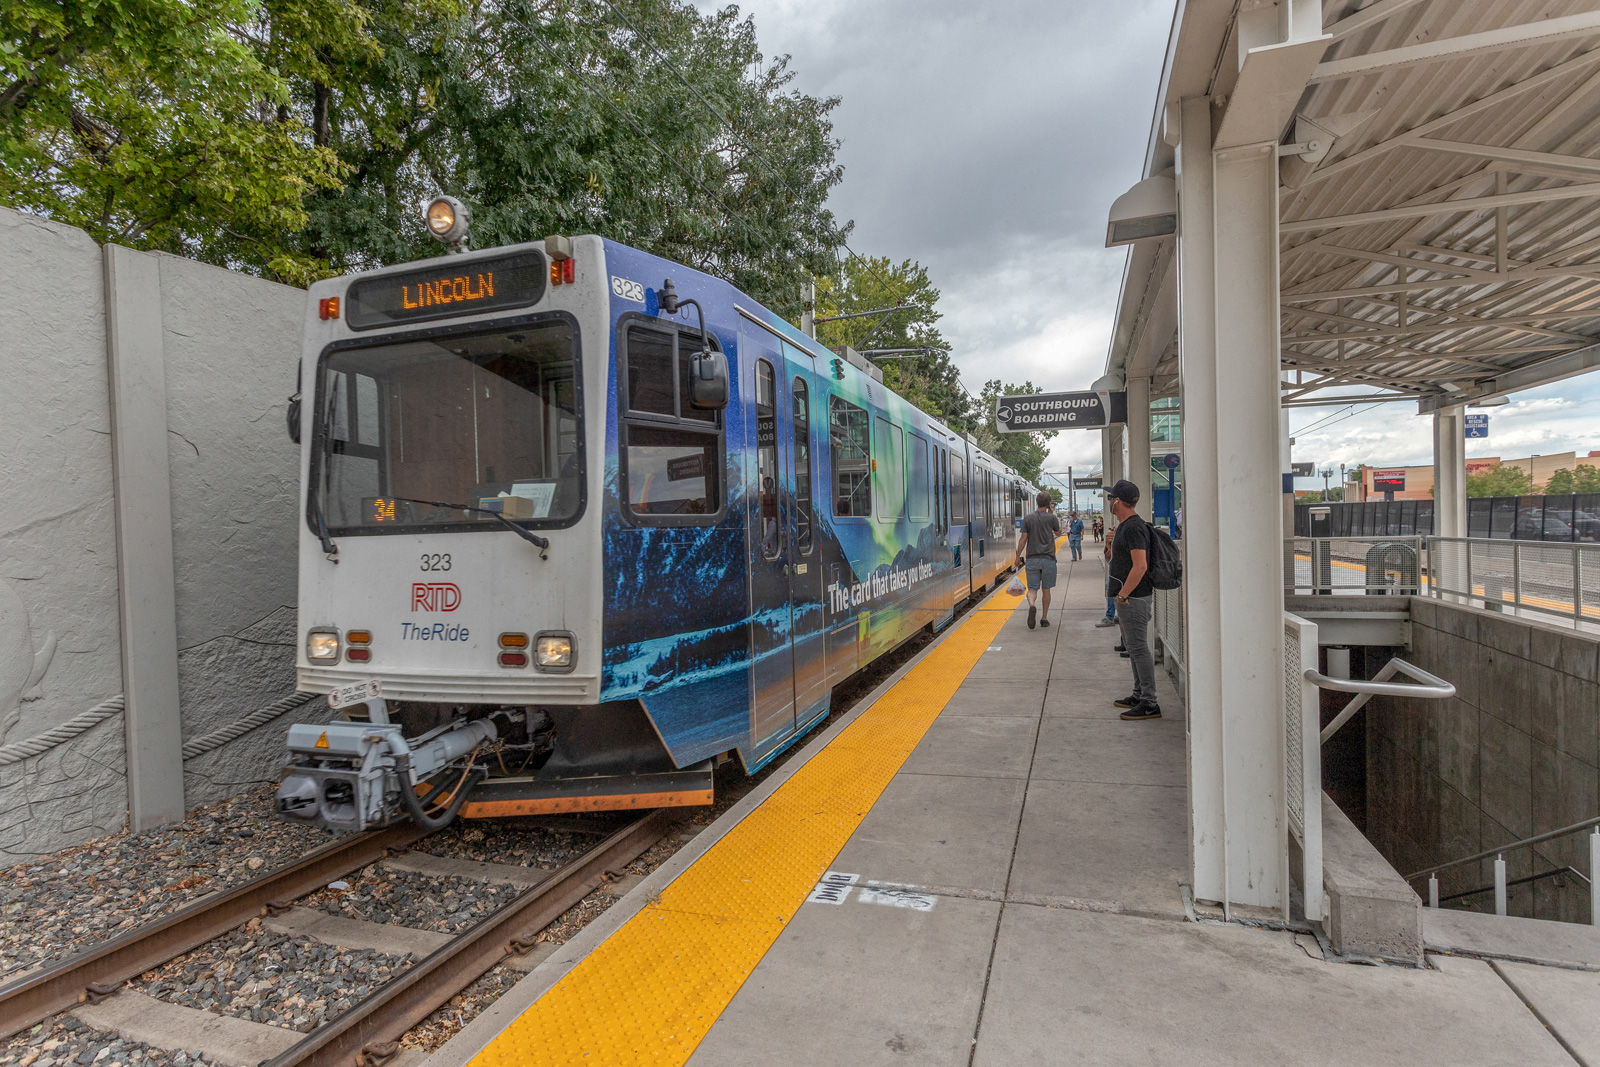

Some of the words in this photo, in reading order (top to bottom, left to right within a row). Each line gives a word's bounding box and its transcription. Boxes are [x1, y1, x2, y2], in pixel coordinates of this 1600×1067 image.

[402, 272, 494, 310] LINCOLN
[613, 278, 644, 301] 323
[1014, 398, 1098, 412] SOUTHBOUND
[1014, 412, 1076, 424] BOARDING
[374, 499, 395, 521] 34
[420, 553, 452, 572] 323
[411, 582, 462, 612] RTD
[827, 580, 849, 615] The
[850, 572, 871, 607] card
[872, 570, 889, 599] that
[889, 565, 907, 592] takes
[907, 566, 918, 591] you
[401, 622, 470, 642] TheRide
[342, 687, 352, 696] DO
[354, 683, 367, 691] NOT
[344, 691, 368, 703] CROSS
[816, 874, 852, 901] DOOR
